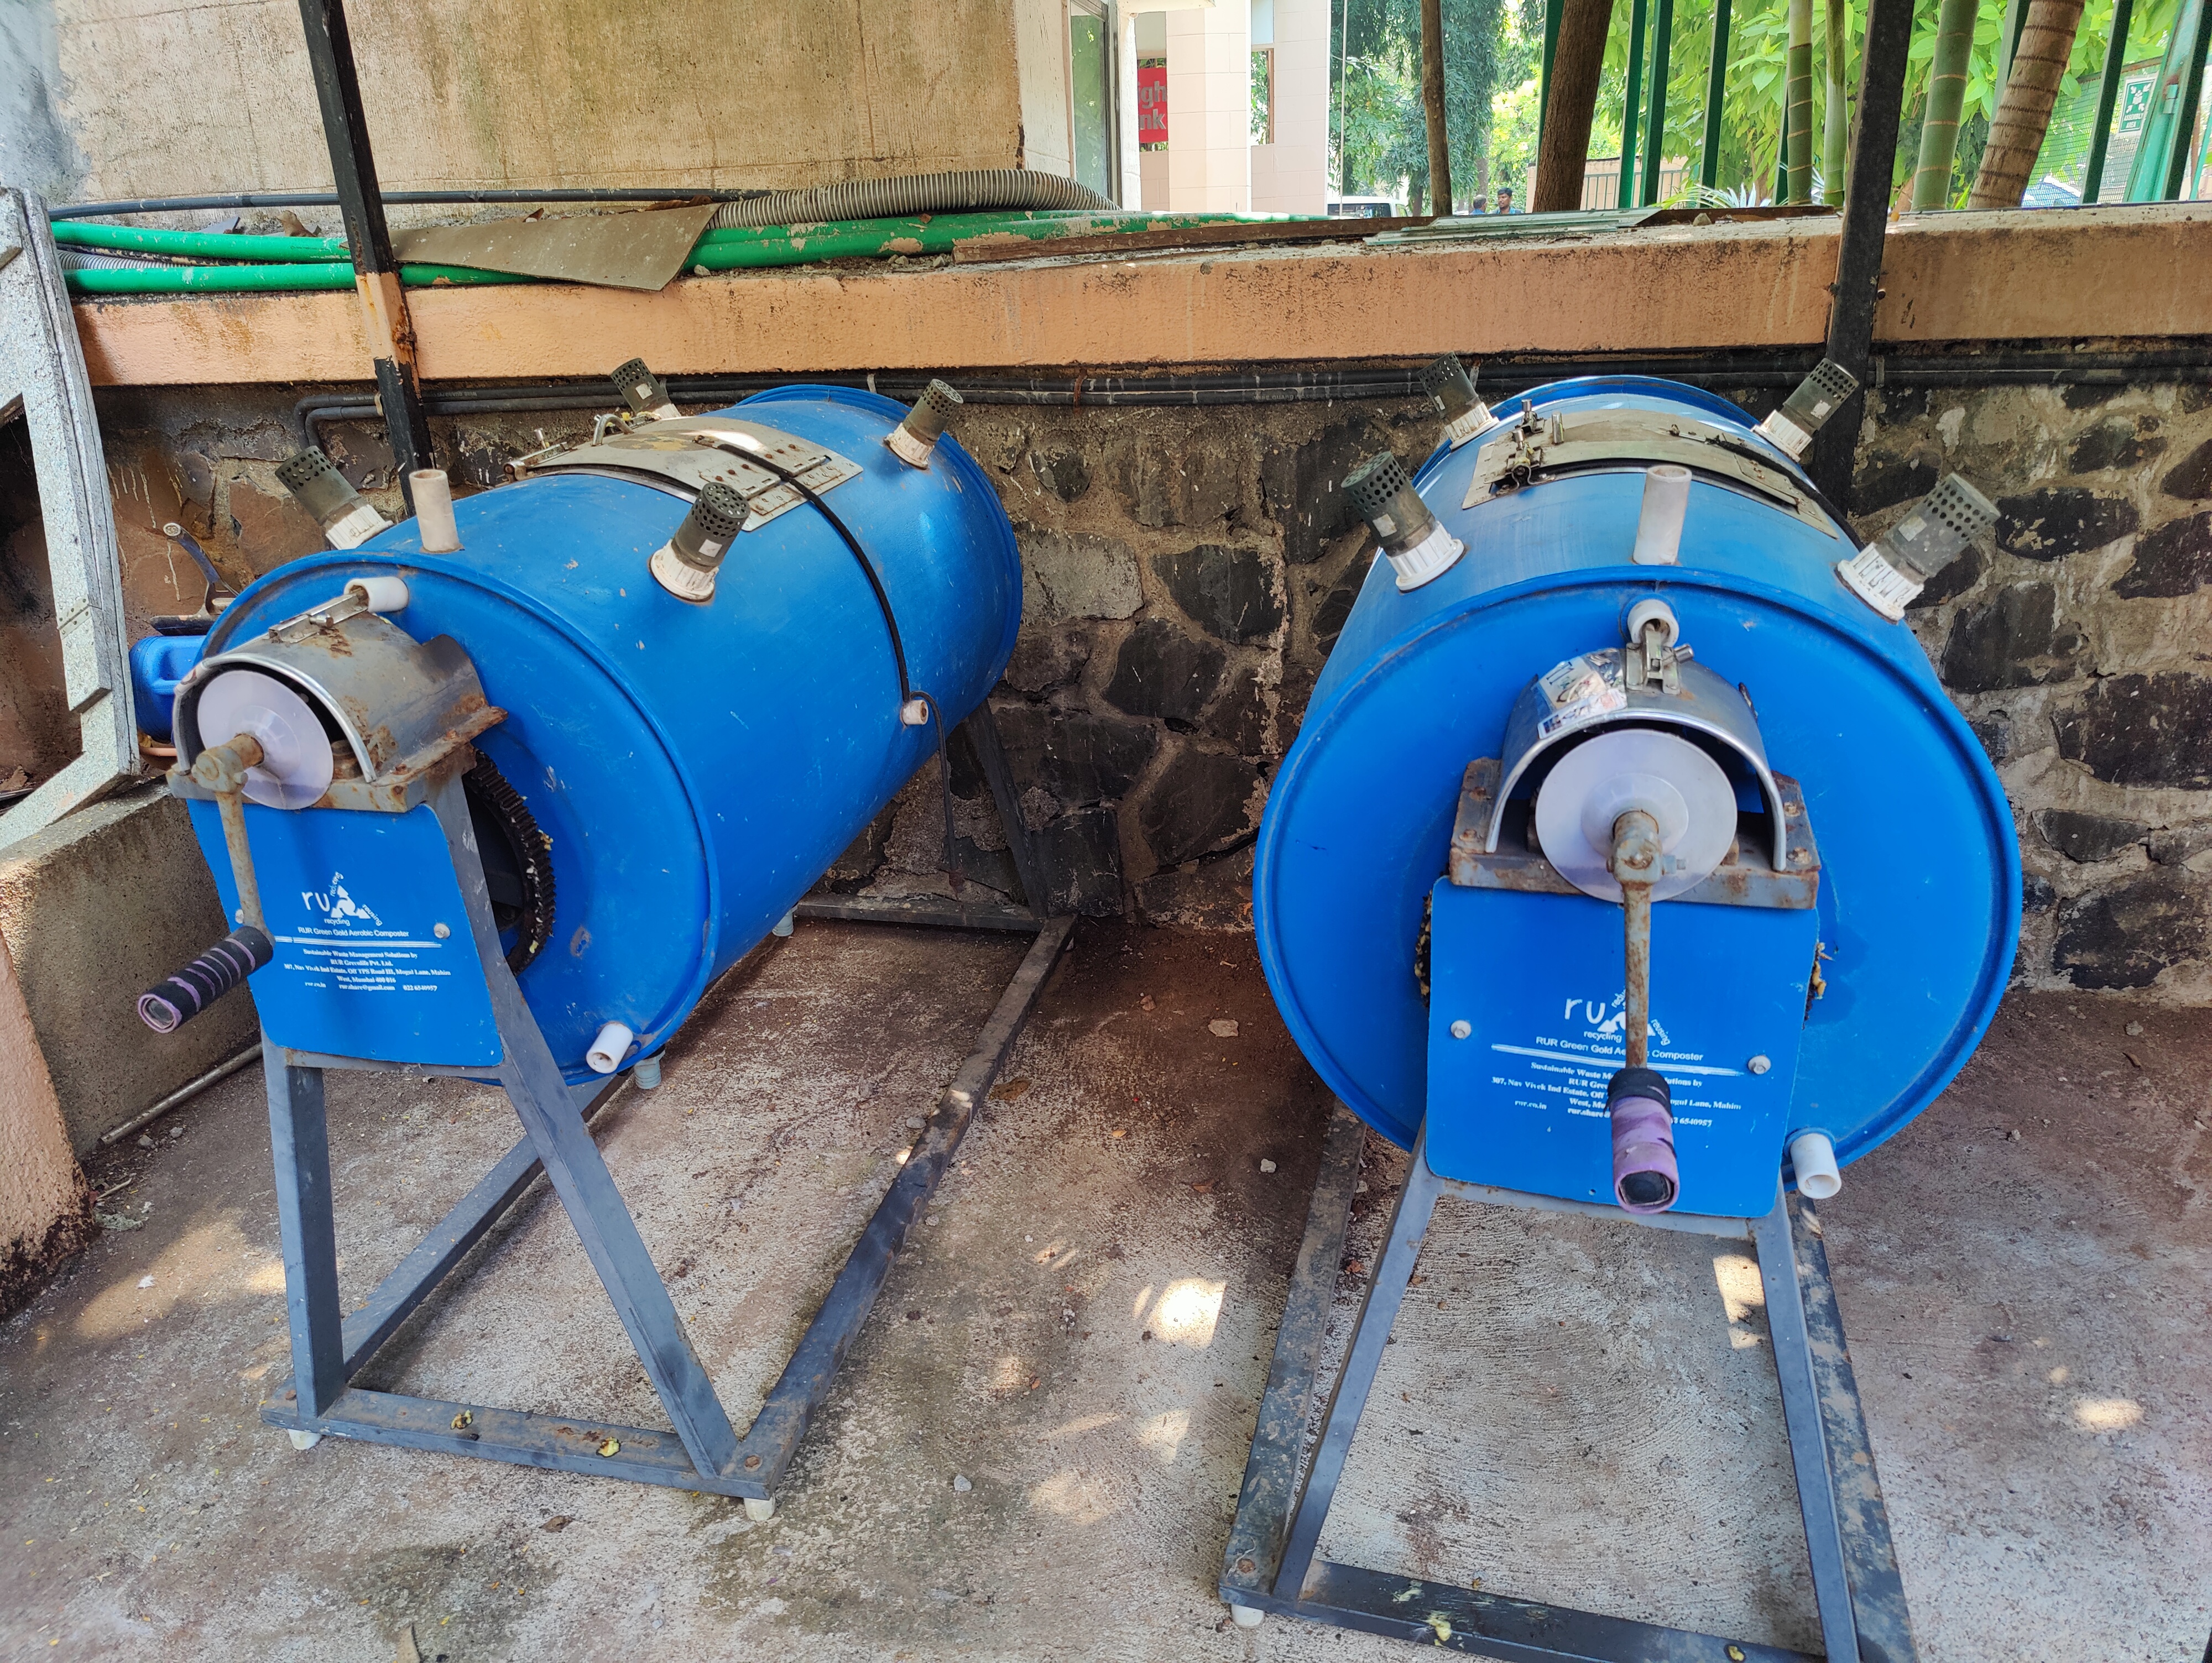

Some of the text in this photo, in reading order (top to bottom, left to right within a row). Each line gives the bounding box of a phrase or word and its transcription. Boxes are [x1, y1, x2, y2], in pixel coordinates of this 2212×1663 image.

[2124, 113, 2144, 121] ASSEMBLY
[324, 918, 351, 927] recycling
[362, 904, 383, 927] reusing
[298, 926, 314, 934] RUR
[374, 929, 409, 938] Composter
[1583, 1031, 1622, 1044] recycling
[1651, 1019, 1671, 1046] reusing
[1536, 1036, 1558, 1047] RUR
[1559, 1039, 1589, 1052] Green
[1590, 1044, 1613, 1055] Gold
[1652, 1049, 1704, 1061] Composter
[1531, 1061, 1575, 1075] Sustainable
[1577, 1068, 1601, 1079] Waste
[1693, 1079, 1703, 1088] by
[1568, 1078, 1588, 1087] RUR
[1491, 1076, 1507, 1086] 307,
[1508, 1078, 1522, 1087] Nav
[1525, 1081, 1546, 1091] Vivek
[1548, 1084, 1562, 1093] Ind
[1590, 1090, 1605, 1099] Off
[1689, 1099, 1712, 1108] Lane,
[1713, 1101, 1741, 1110] Mahim
[1569, 1097, 1591, 1108] West,
[1515, 1100, 1547, 1110] rur.co.in
[1679, 1117, 1713, 1128] 6540957
